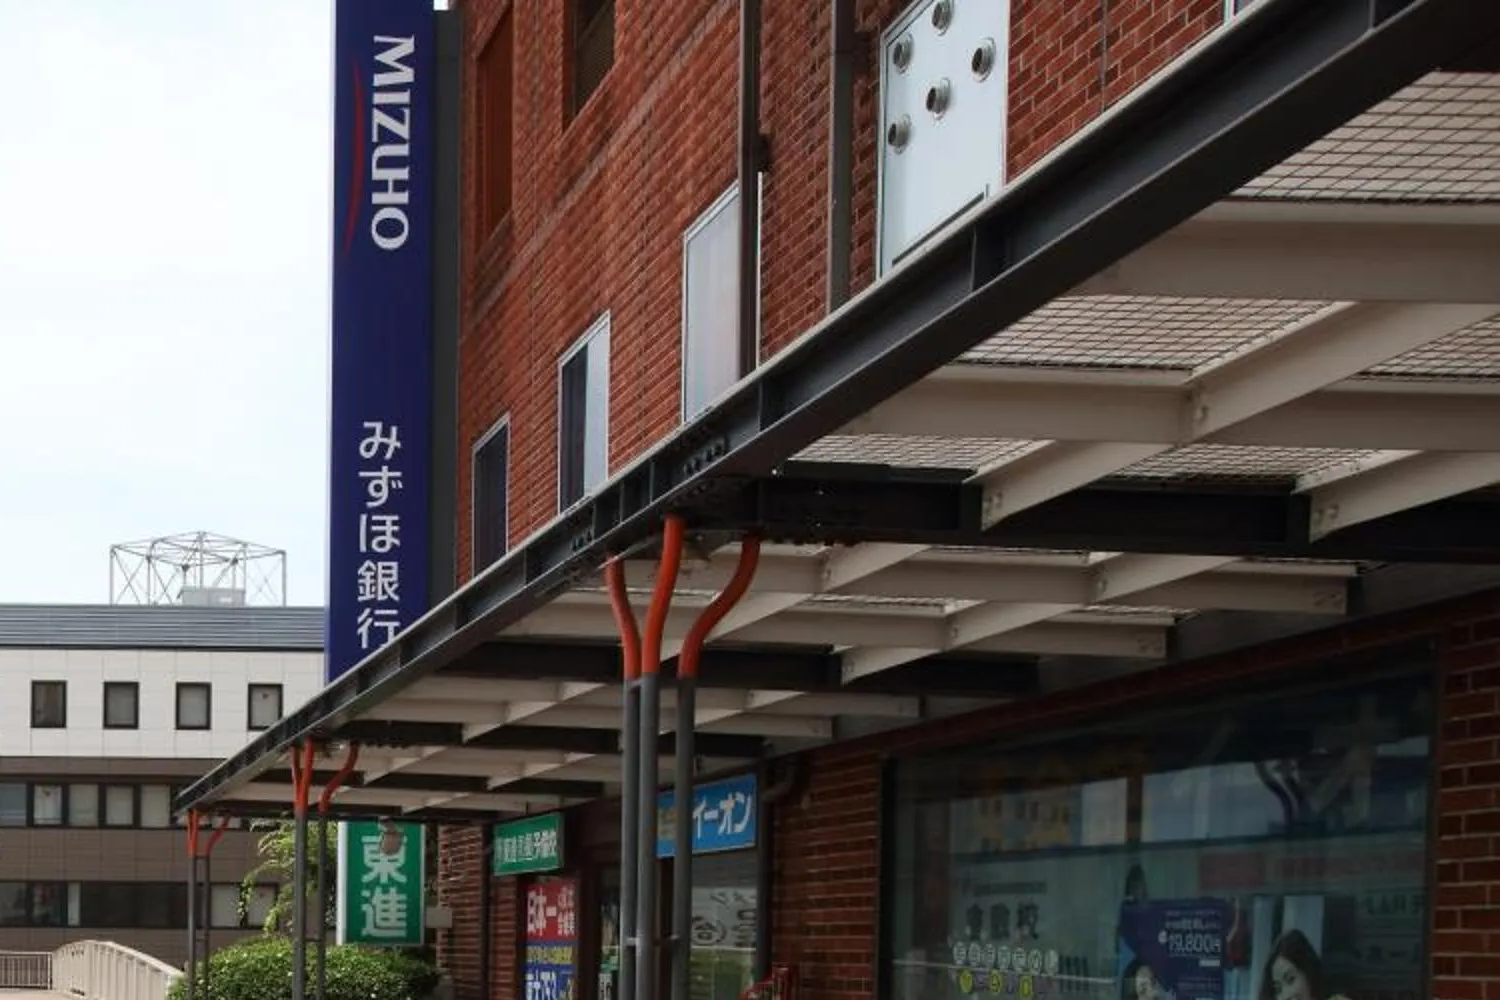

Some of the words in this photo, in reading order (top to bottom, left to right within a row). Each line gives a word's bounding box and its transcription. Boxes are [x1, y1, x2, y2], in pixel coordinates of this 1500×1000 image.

[371, 35, 415, 250] MIZUHO
[357, 421, 403, 650] みずほ銀行
[361, 828, 407, 937] 東進
[692, 792, 751, 839] イーオン
